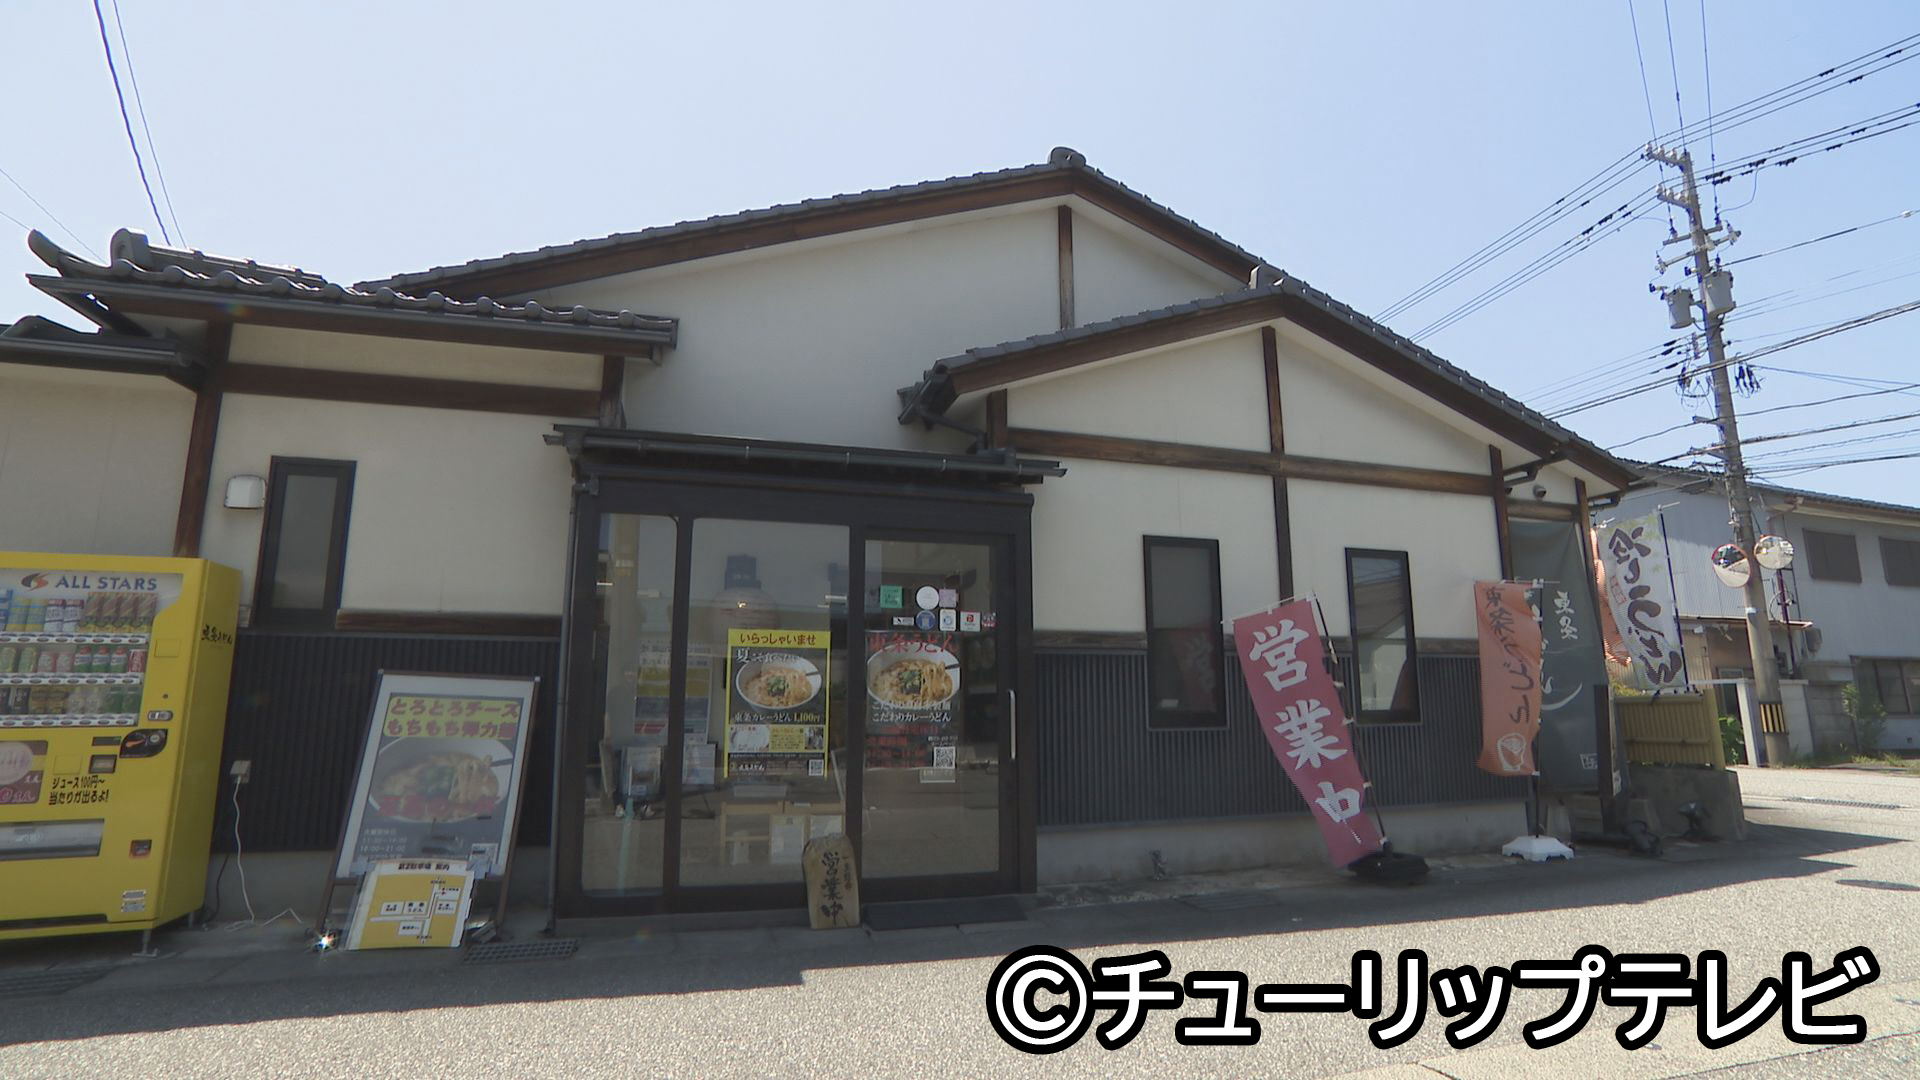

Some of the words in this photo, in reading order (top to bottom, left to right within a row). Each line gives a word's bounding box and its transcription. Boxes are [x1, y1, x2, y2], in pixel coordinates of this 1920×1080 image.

[55, 575, 91, 589] ALL
[97, 576, 158, 591] STARS
[740, 633, 816, 646] いらっしゃいませ
[872, 711, 951, 722] こだわりカレーうどん
[1249, 619, 1362, 844] 営業中
[820, 851, 844, 926] 営業中
